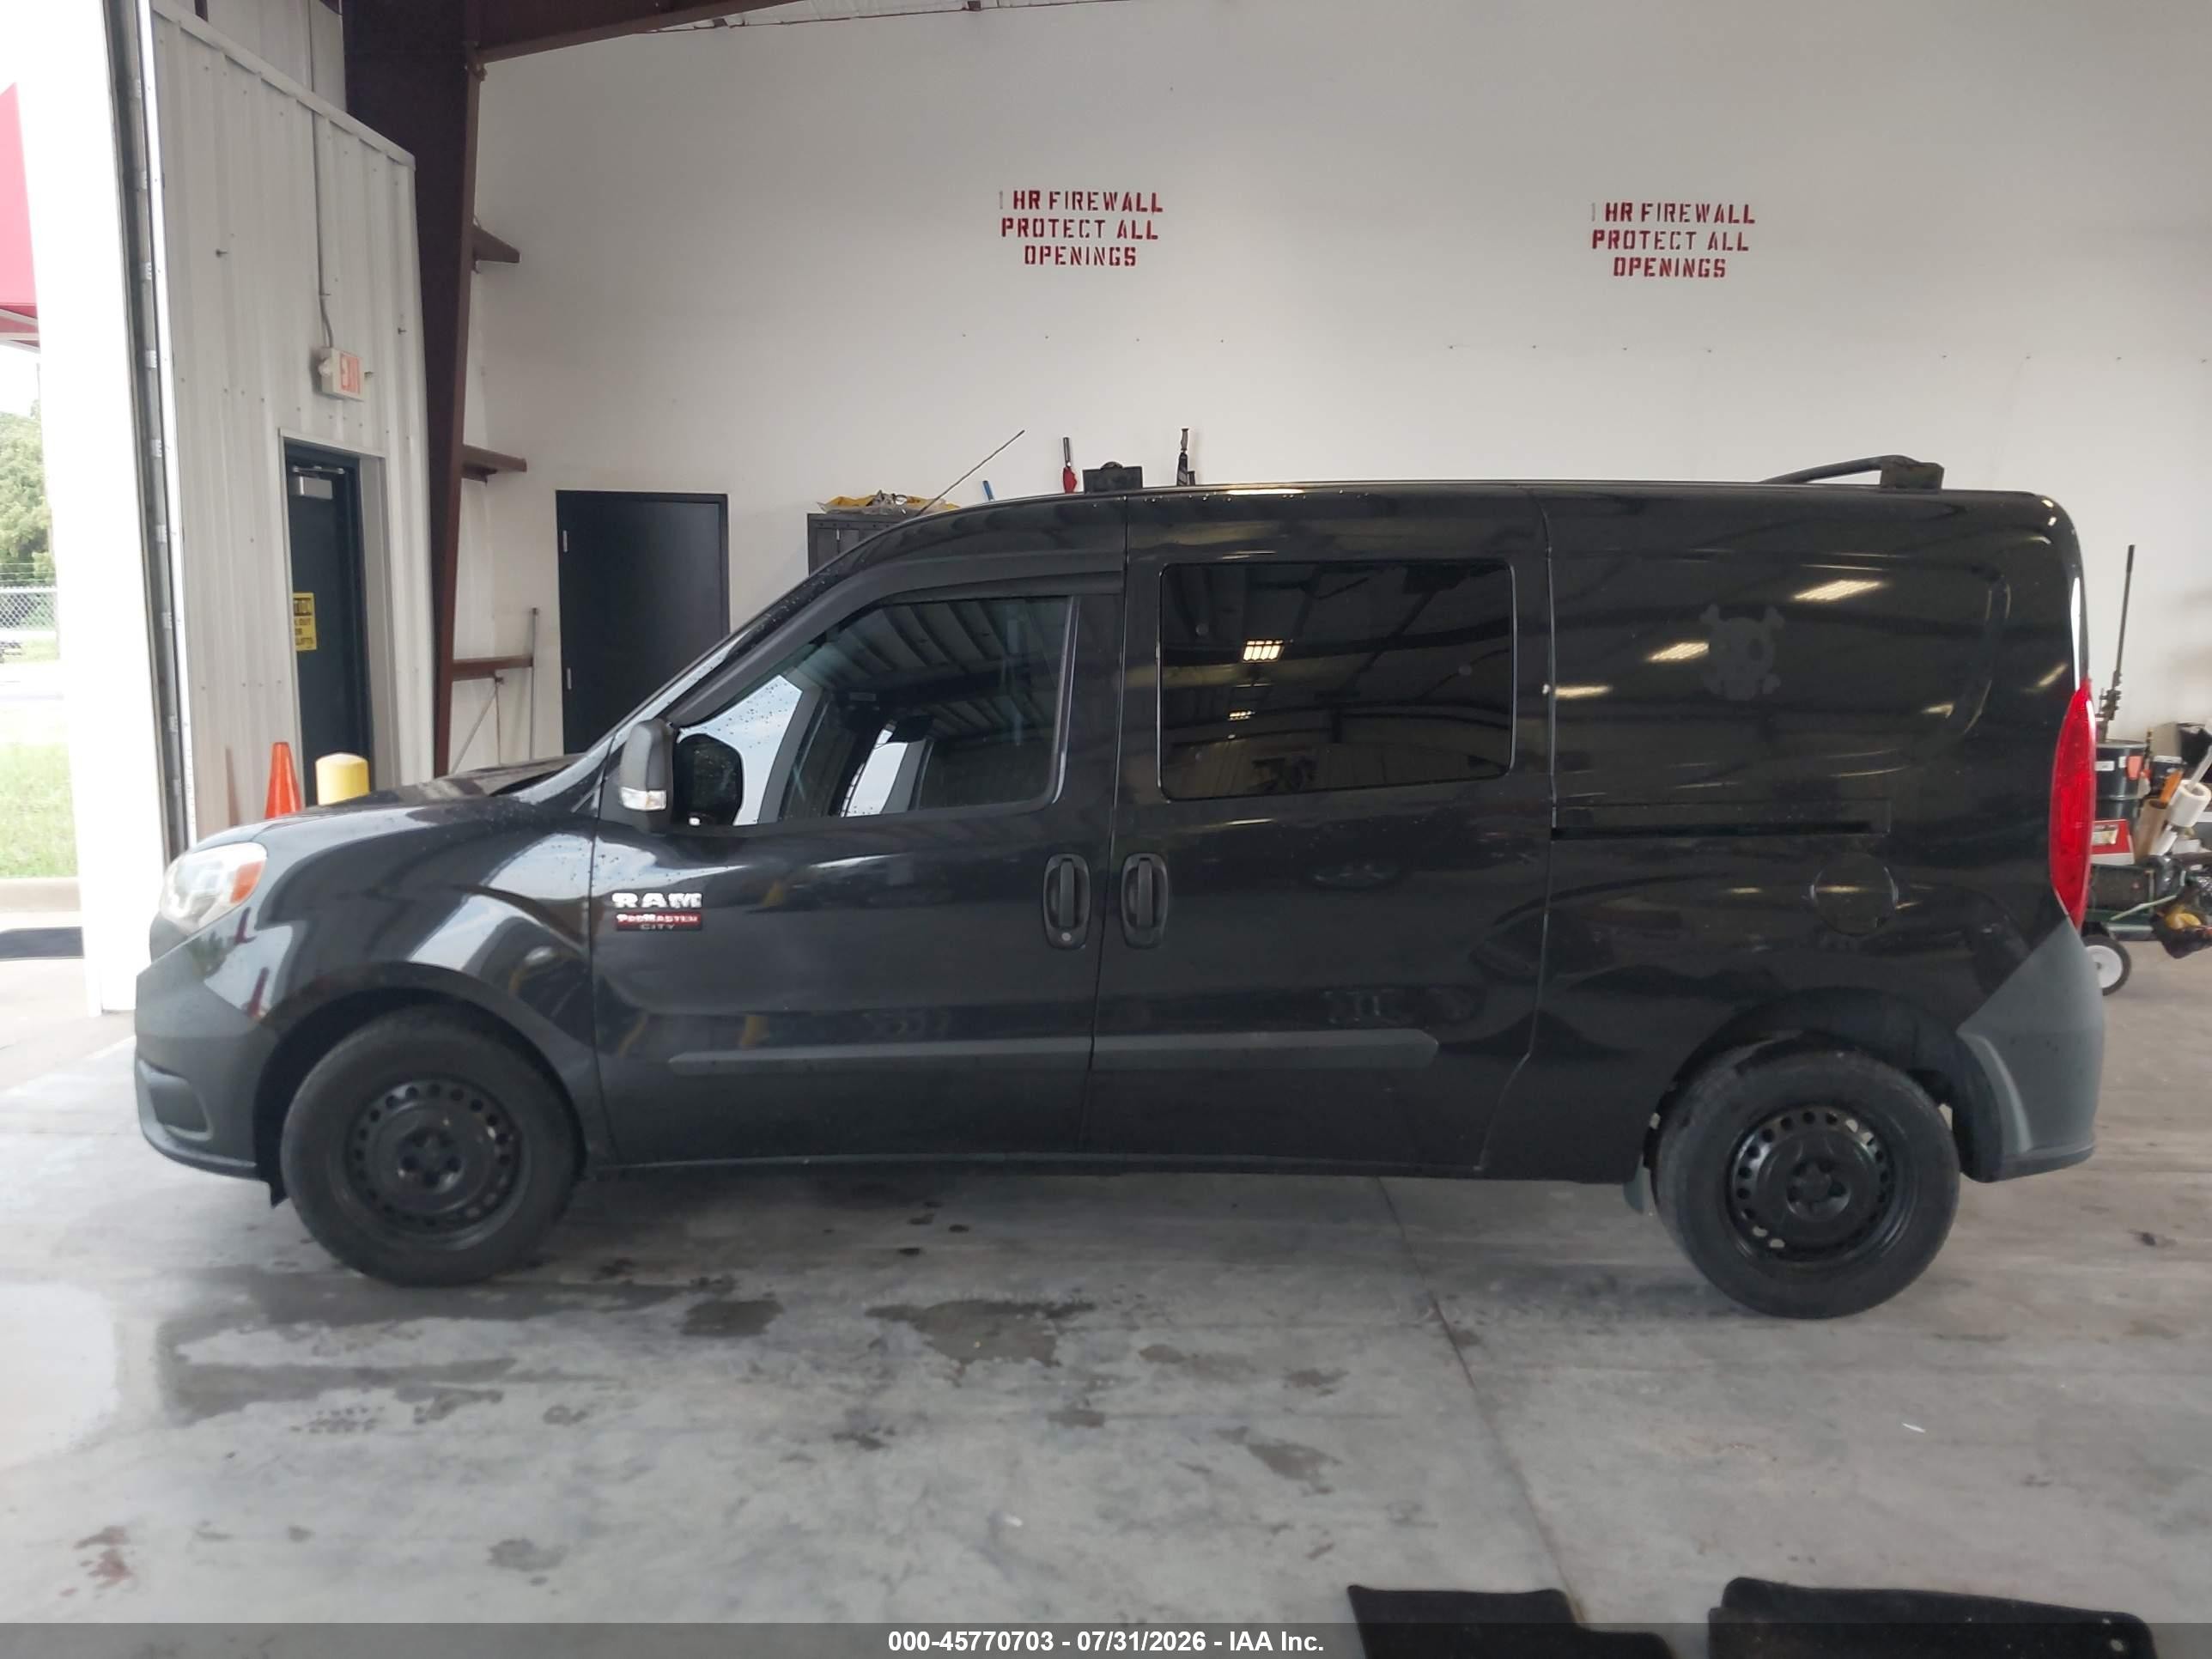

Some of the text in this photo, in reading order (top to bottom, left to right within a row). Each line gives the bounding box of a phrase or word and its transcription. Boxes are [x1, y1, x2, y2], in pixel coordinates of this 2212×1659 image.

[1013, 190, 1041, 210] HR
[1049, 191, 1164, 213] FIREWALL
[1605, 202, 1633, 222] HR
[1641, 203, 1756, 224] FIREWALL
[1001, 217, 1159, 240] PROTECT ALL
[1592, 229, 1749, 252] PROTECT ALL
[1024, 245, 1137, 267] OPENINGS
[1613, 257, 1727, 278] OPENINGS
[611, 892, 702, 908] RAM
